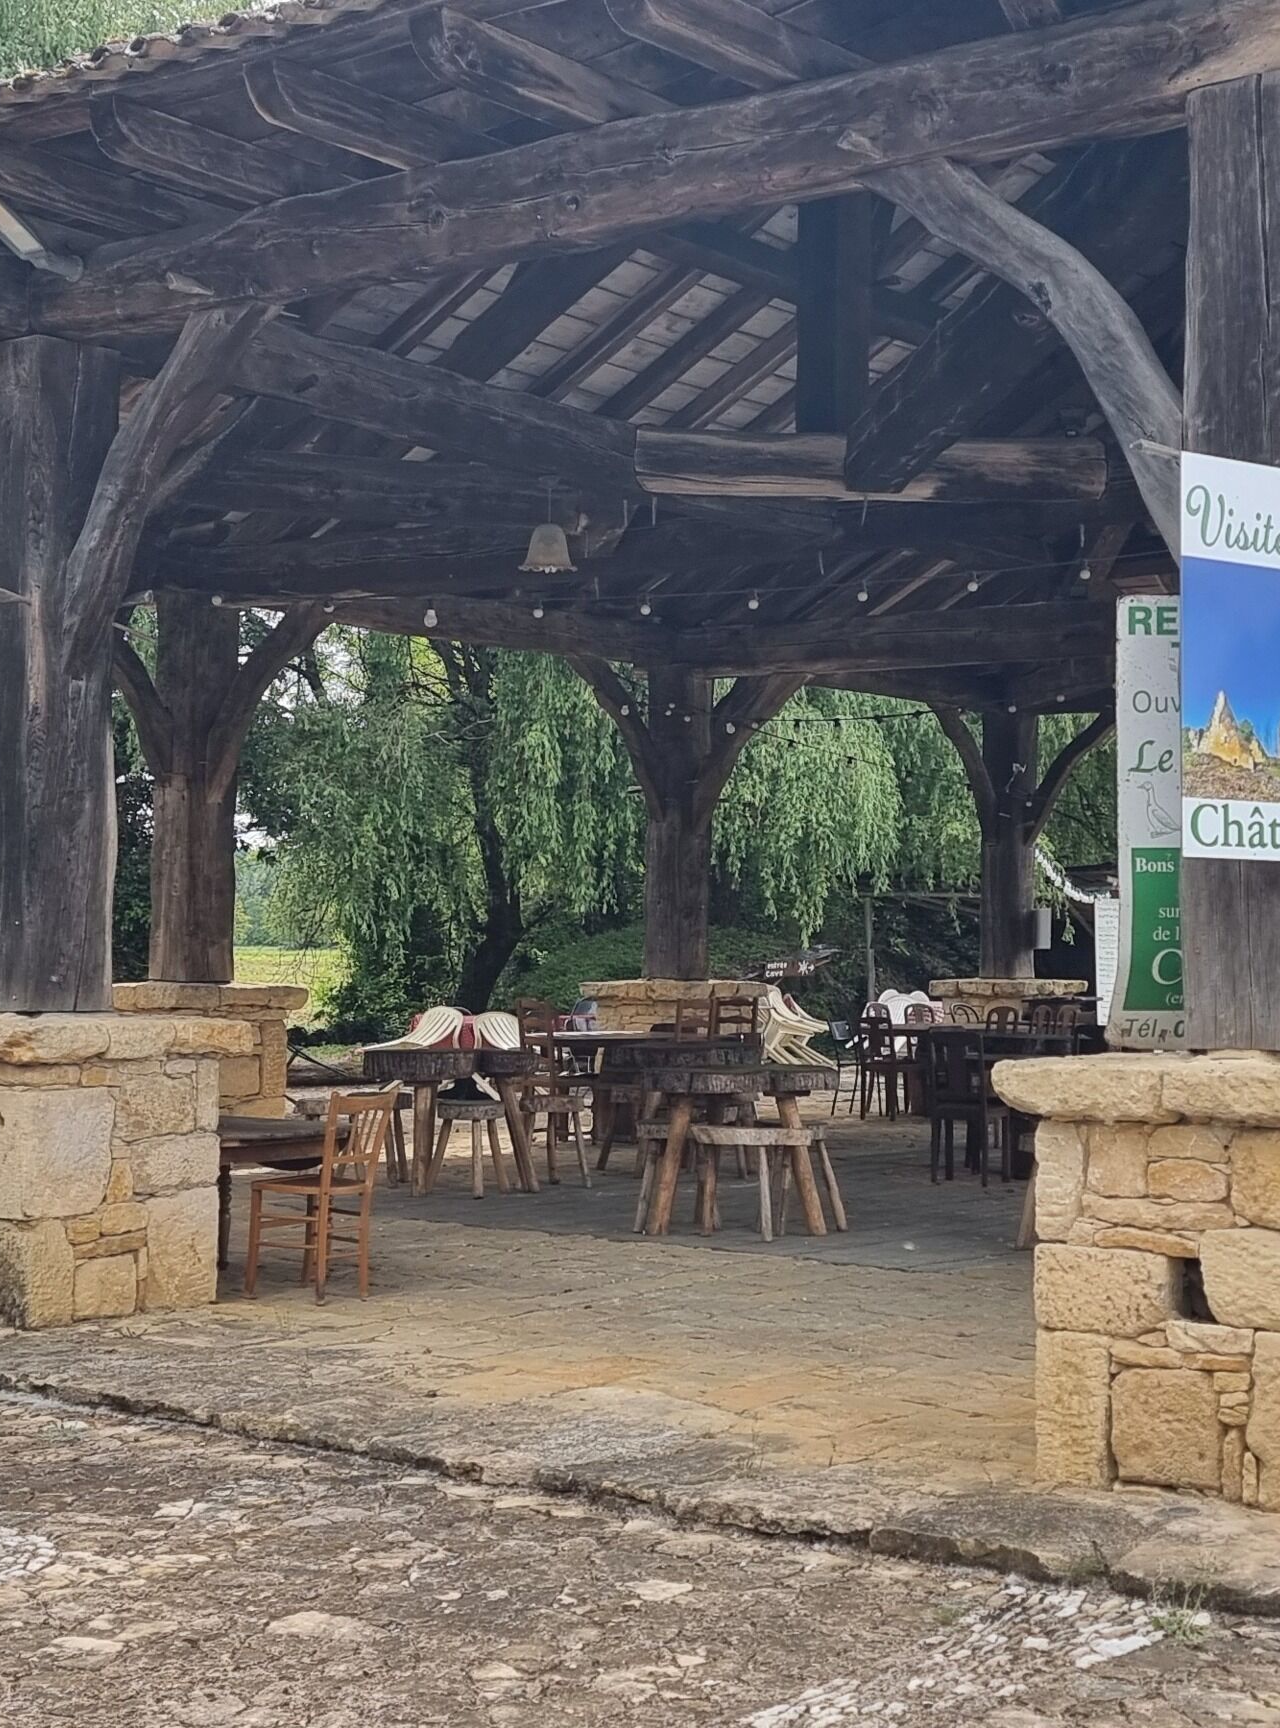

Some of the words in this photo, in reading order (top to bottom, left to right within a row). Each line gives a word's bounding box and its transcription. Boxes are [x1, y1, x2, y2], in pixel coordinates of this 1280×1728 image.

[1128, 740, 1175, 774] Le
[1135, 857, 1175, 873] Bons
[1152, 926, 1171, 941] de
